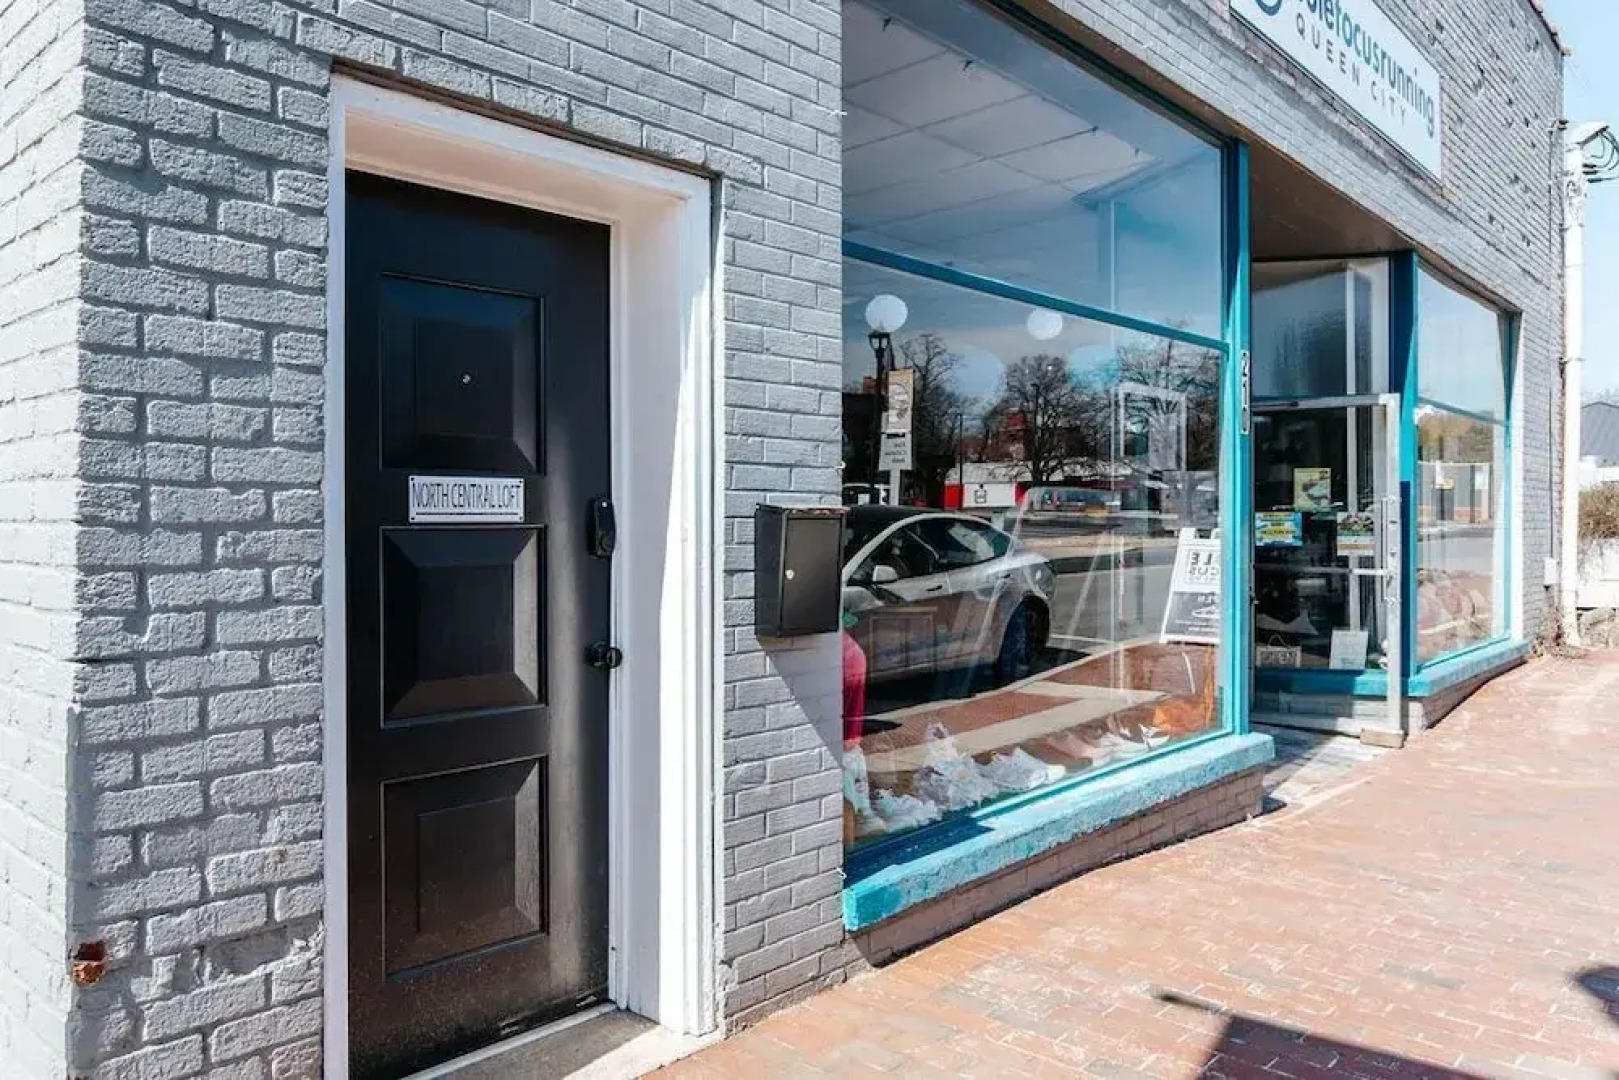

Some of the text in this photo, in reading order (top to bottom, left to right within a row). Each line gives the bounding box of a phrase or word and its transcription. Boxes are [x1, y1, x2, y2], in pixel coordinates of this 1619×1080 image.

[1296, 12, 1406, 126] QUEEN CITY
[412, 482, 522, 509] NORTH CENTRAL LOFT
